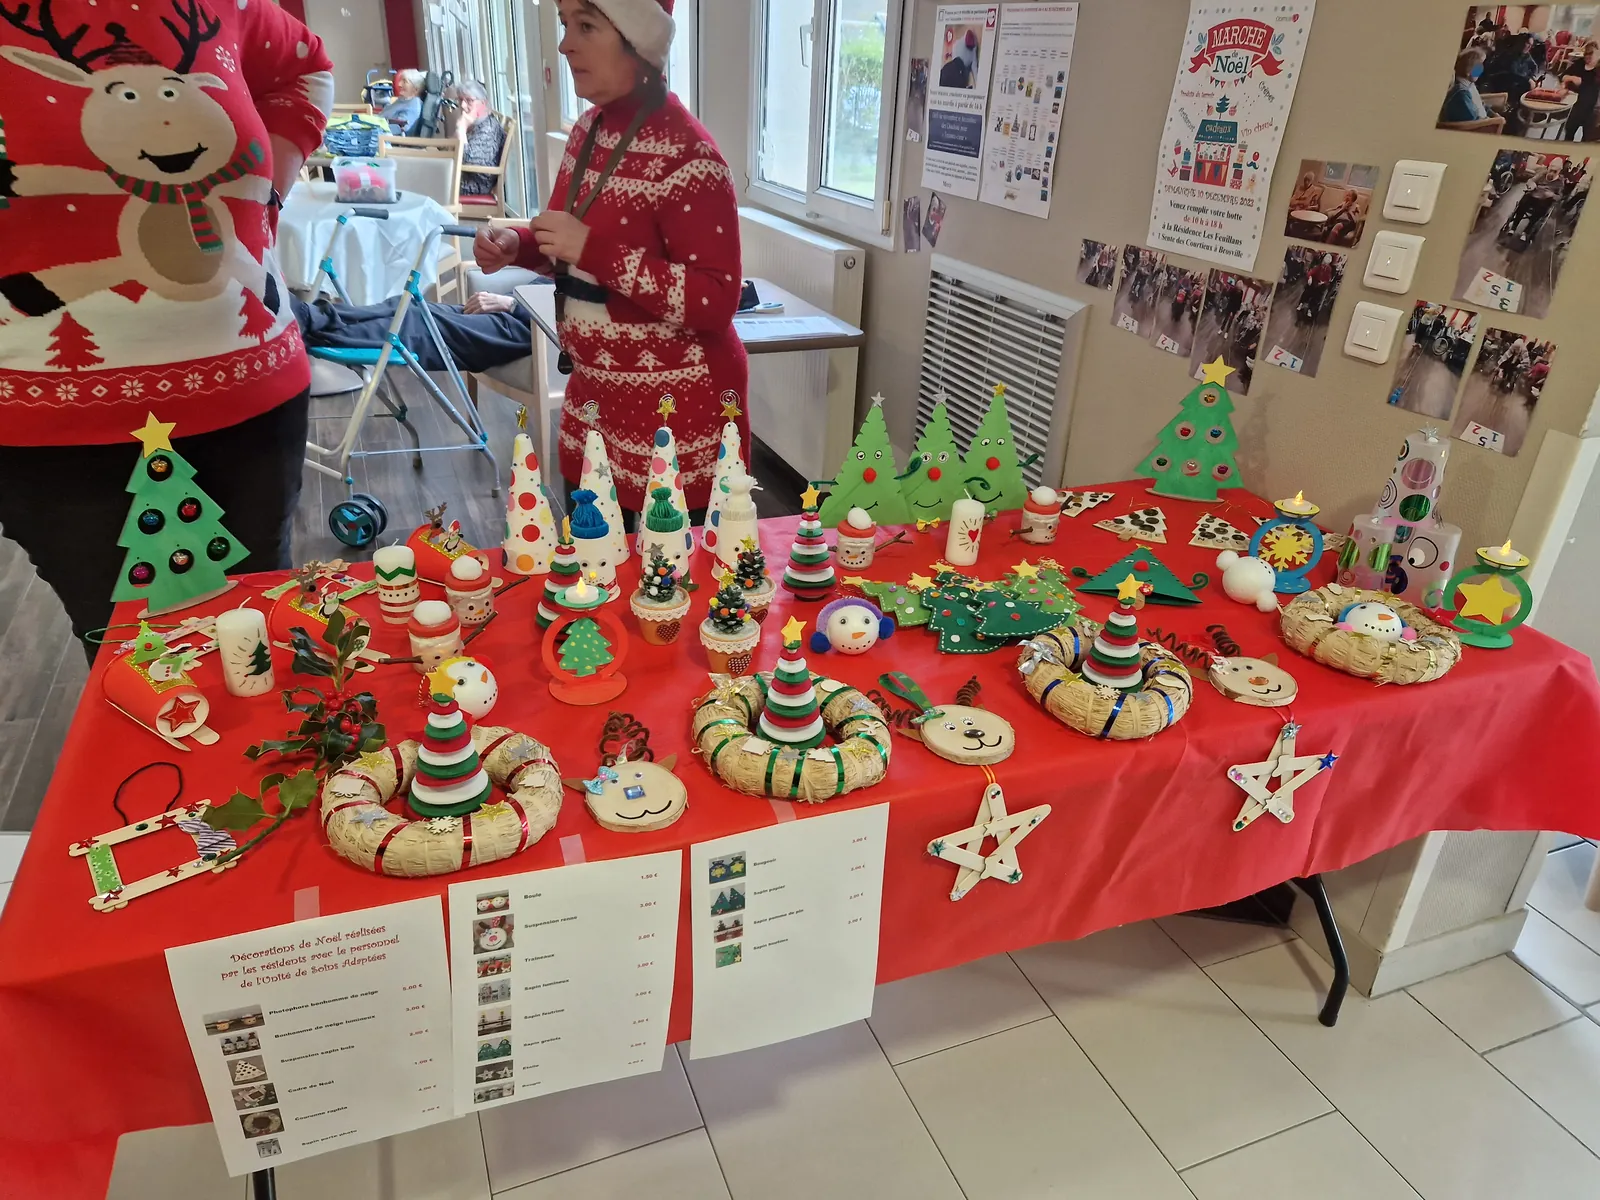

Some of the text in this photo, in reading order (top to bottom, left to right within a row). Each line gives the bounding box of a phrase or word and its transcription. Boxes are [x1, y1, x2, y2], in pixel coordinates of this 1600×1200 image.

[1231, 50, 1238, 58] de
[1212, 55, 1249, 74] Noël
[1205, 122, 1232, 133] cadeaux
[1254, 117, 1274, 133] chaud
[1169, 200, 1186, 210] Venez
[1186, 204, 1209, 215] remplir
[1209, 208, 1225, 218] votre
[1183, 214, 1191, 222] de
[1210, 218, 1218, 227] 18
[1218, 220, 1223, 230] h
[1162, 222, 1166, 230] à
[1166, 222, 1173, 231] la
[1173, 223, 1202, 238] Résidence
[1203, 230, 1214, 240] Les
[1161, 234, 1175, 243] Sente
[1175, 236, 1185, 245] des
[1218, 245, 1244, 258] Brosville
[1482, 272, 1494, 283] 2
[1490, 284, 1501, 296] 5
[1506, 280, 1514, 292] 1
[1499, 297, 1510, 312] 3
[1274, 350, 1284, 360] 2
[1290, 358, 1297, 368] 1
[1472, 425, 1481, 435] 2
[1478, 436, 1488, 447] 5
[1492, 432, 1499, 442] 1
[524, 919, 560, 928] Suspension
[230, 924, 387, 964] Décorations de Noël réalisées
[221, 933, 400, 981] par les résidents avec le personnel
[240, 952, 387, 989] de l'Unité de Soins Adaptées
[269, 1003, 310, 1015] Photophore
[310, 995, 349, 1007] bonhomme
[274, 1028, 313, 1039] Bonhomme
[345, 1015, 376, 1025] lumineux
[280, 1052, 320, 1064] Suspension
[287, 1086, 307, 1094] Cadre
